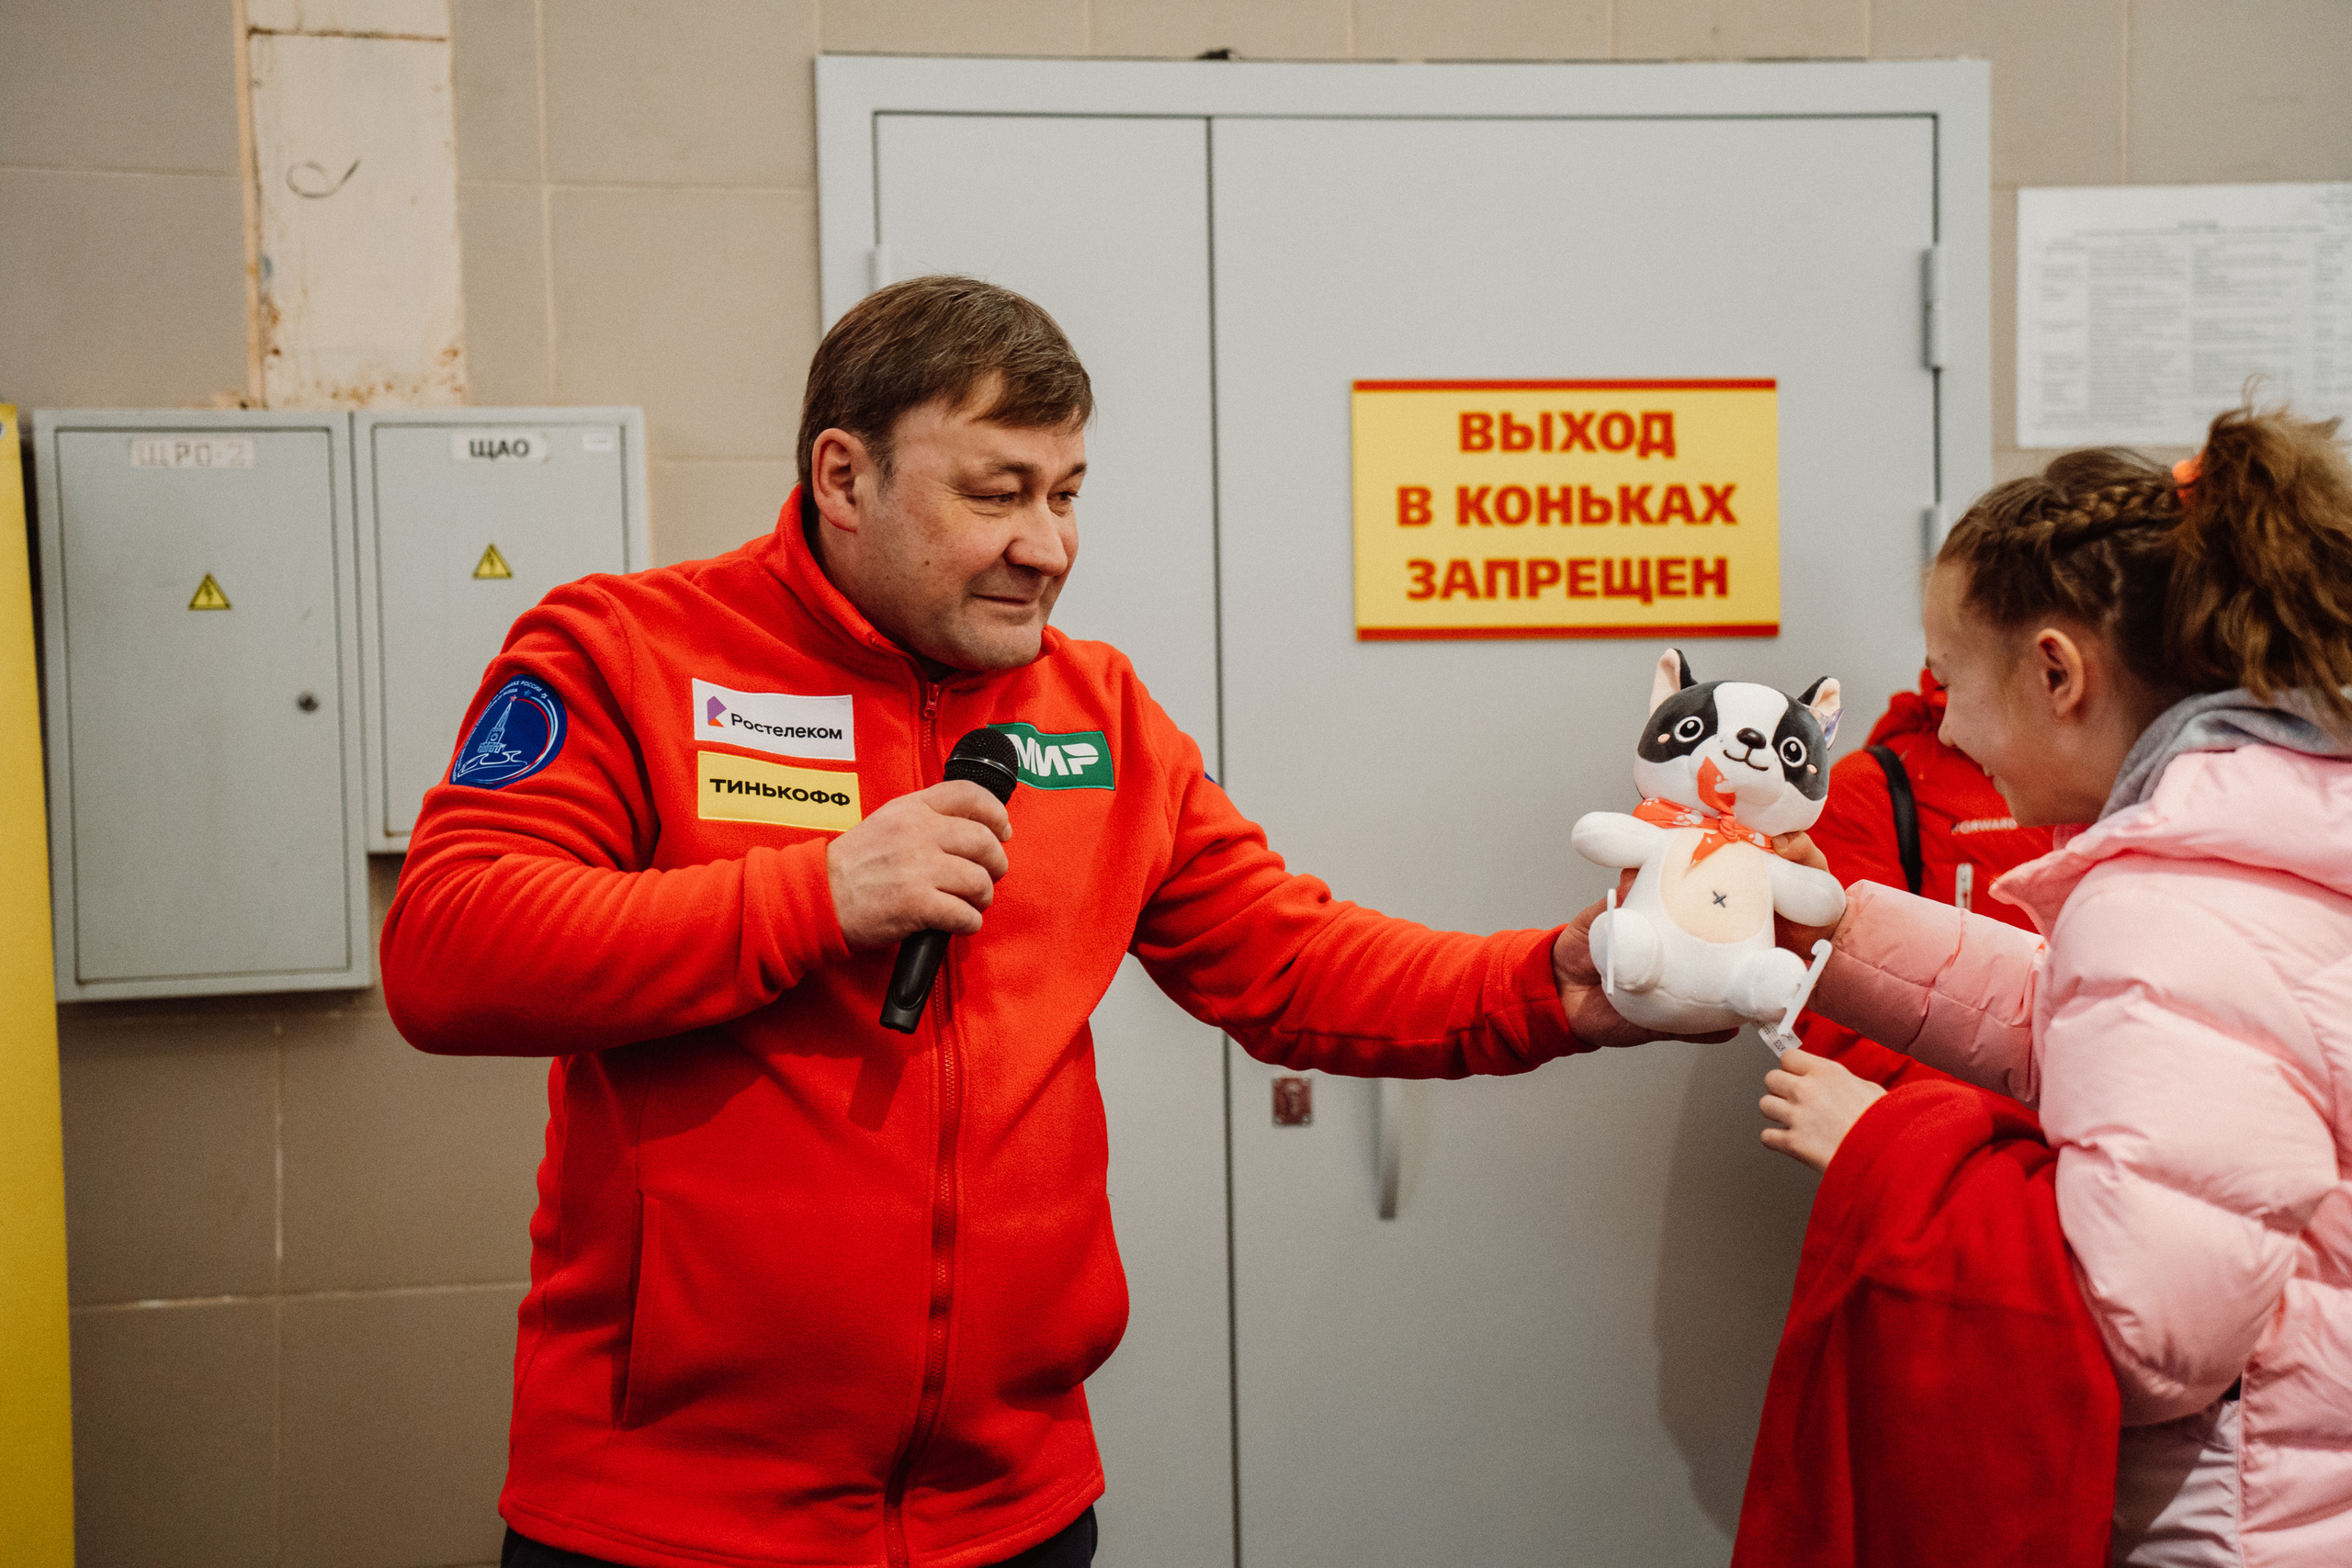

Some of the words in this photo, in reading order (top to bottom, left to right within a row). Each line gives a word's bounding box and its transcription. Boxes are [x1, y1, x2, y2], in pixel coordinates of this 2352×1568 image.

[469, 439, 530, 462] ЩАО
[1459, 412, 1676, 458] ВЫХОД
[1396, 486, 1433, 526] В
[1456, 484, 1737, 525] КОНЬКАХ
[1406, 558, 1729, 605] ЗАПРЕЩЕН
[730, 712, 843, 740] Ростелеком
[1004, 733, 1099, 777] МИР
[709, 778, 851, 807] ТИНЬКОФФ
